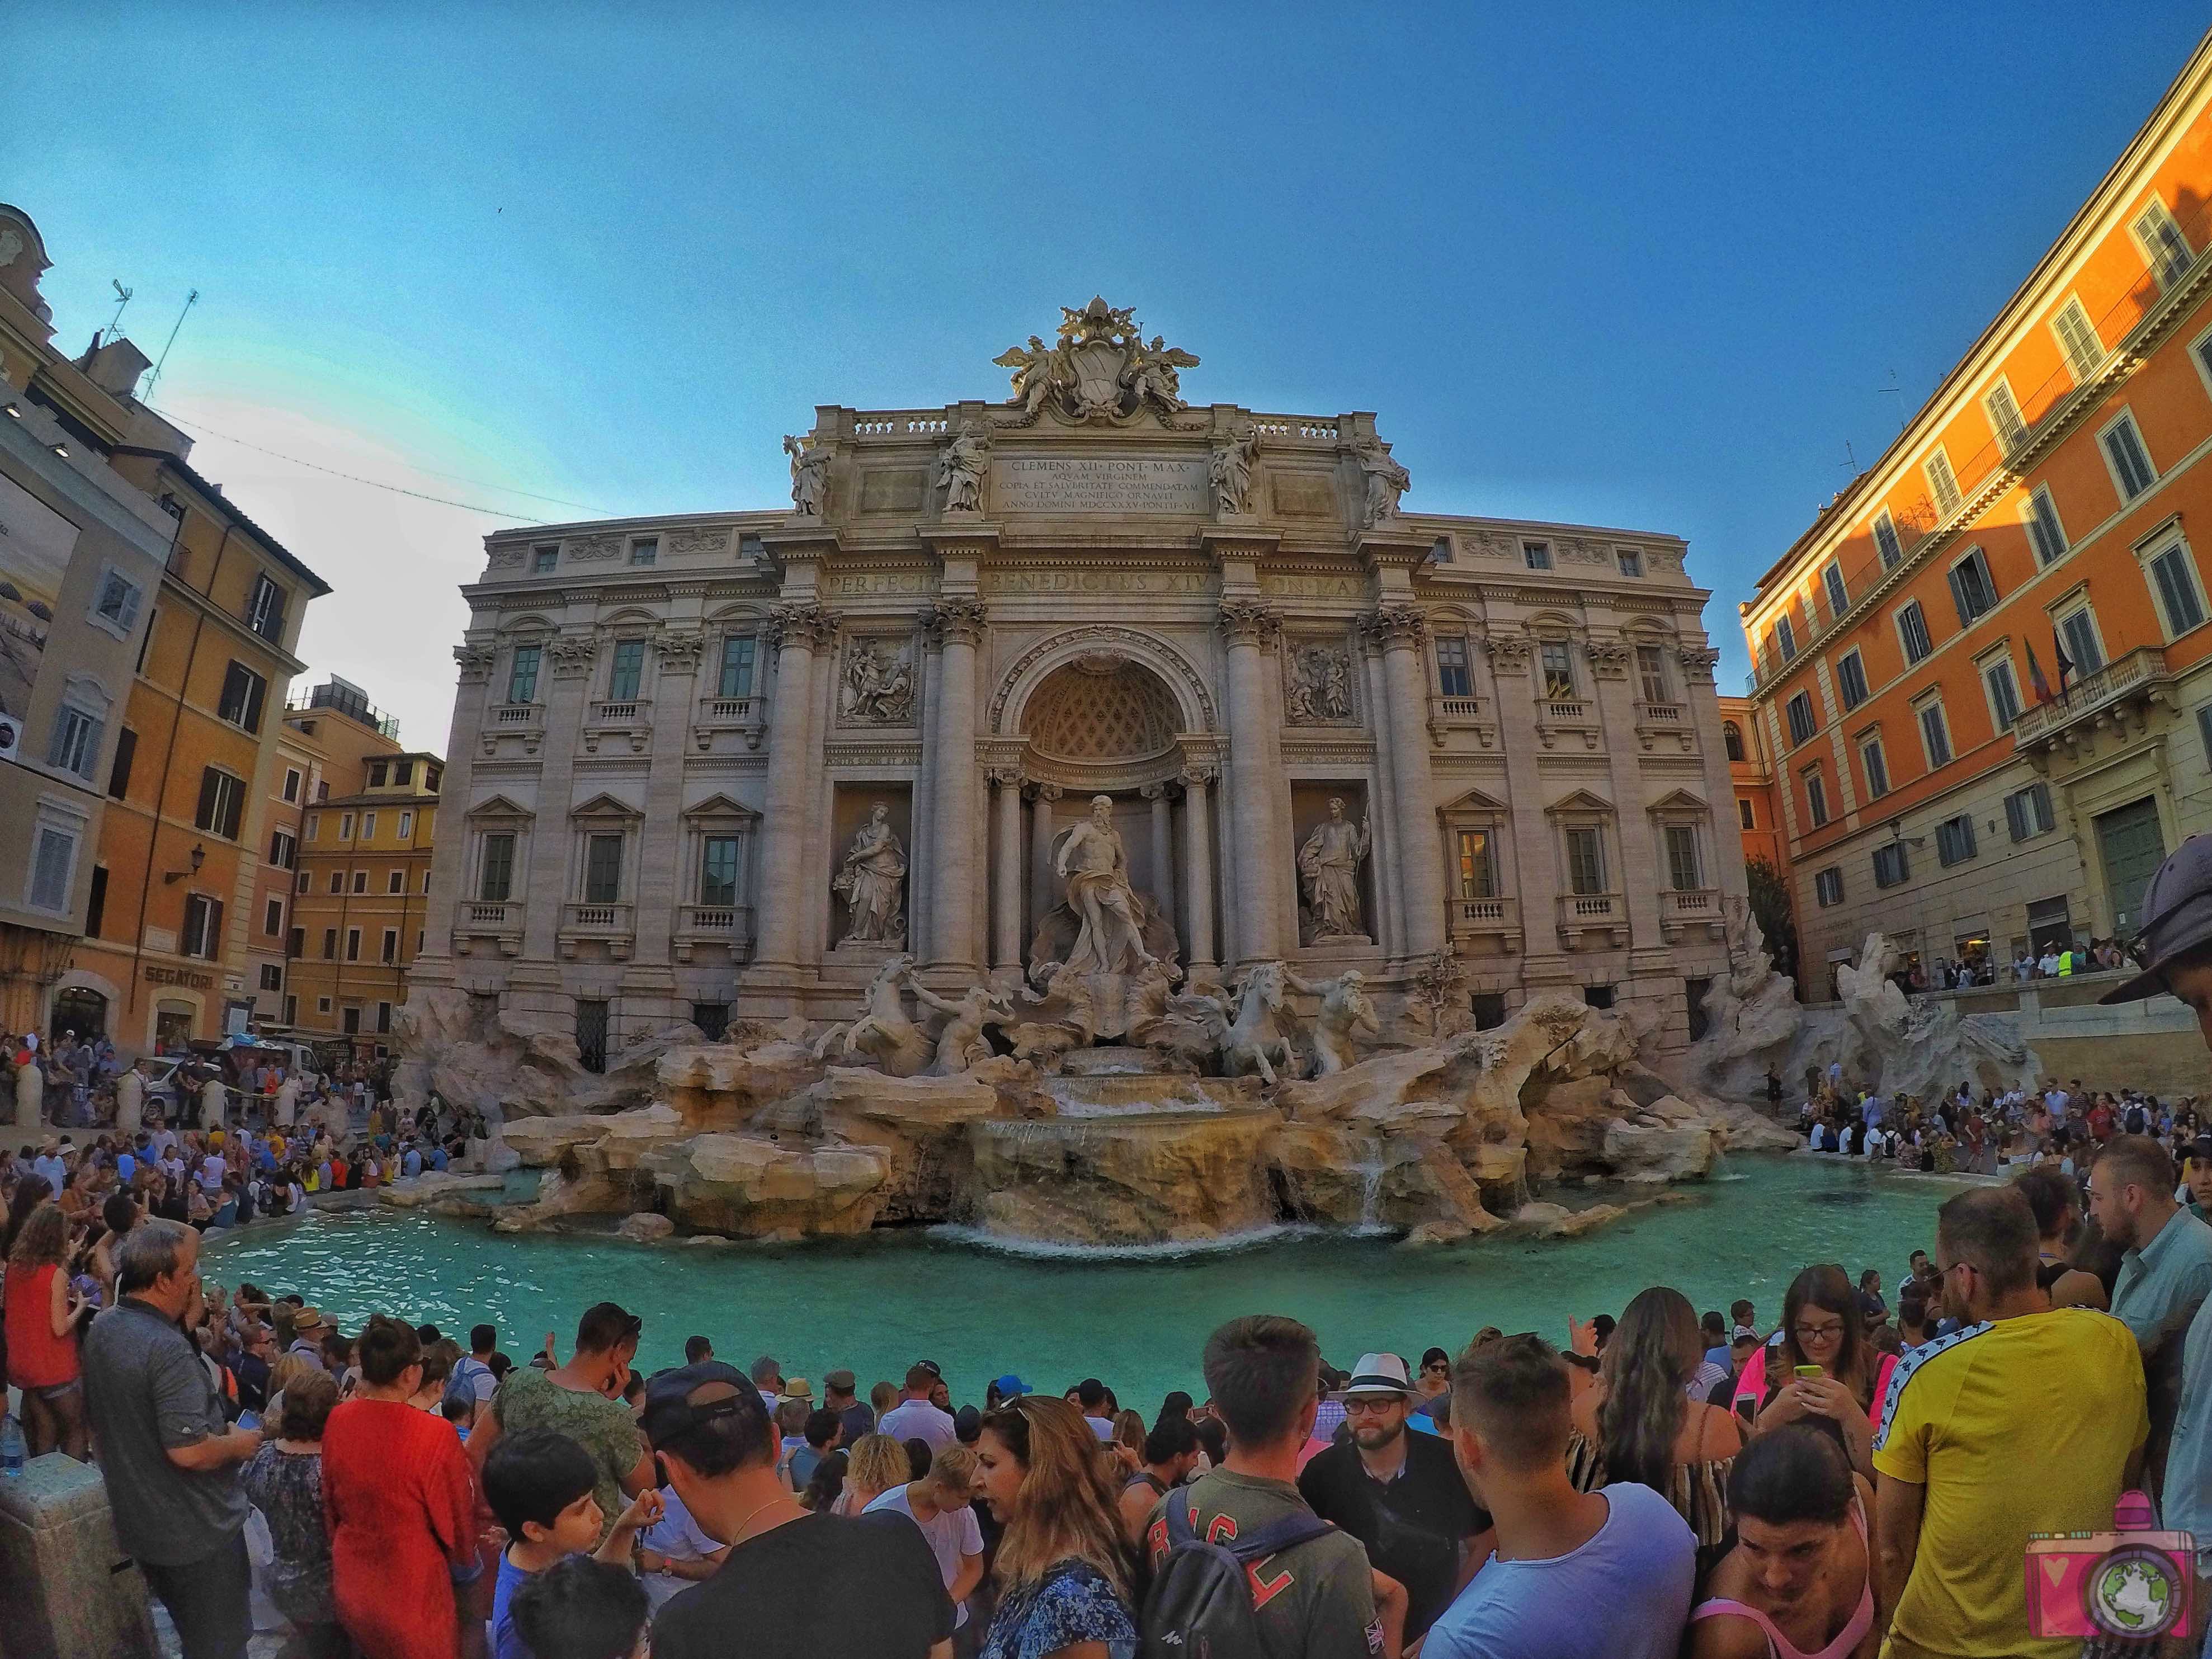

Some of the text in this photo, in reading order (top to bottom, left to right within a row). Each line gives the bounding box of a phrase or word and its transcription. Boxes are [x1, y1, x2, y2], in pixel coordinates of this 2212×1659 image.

[1011, 461, 1072, 471] CLEMENS
[1051, 473, 1089, 482] AQVAM
[1119, 483, 1199, 491] COMMENDATAM
[828, 574, 941, 593] PERFECIT
[991, 573, 1147, 591] BENEDICTVS
[1168, 574, 1208, 591] XIV
[145, 966, 214, 990] SEGATORI
